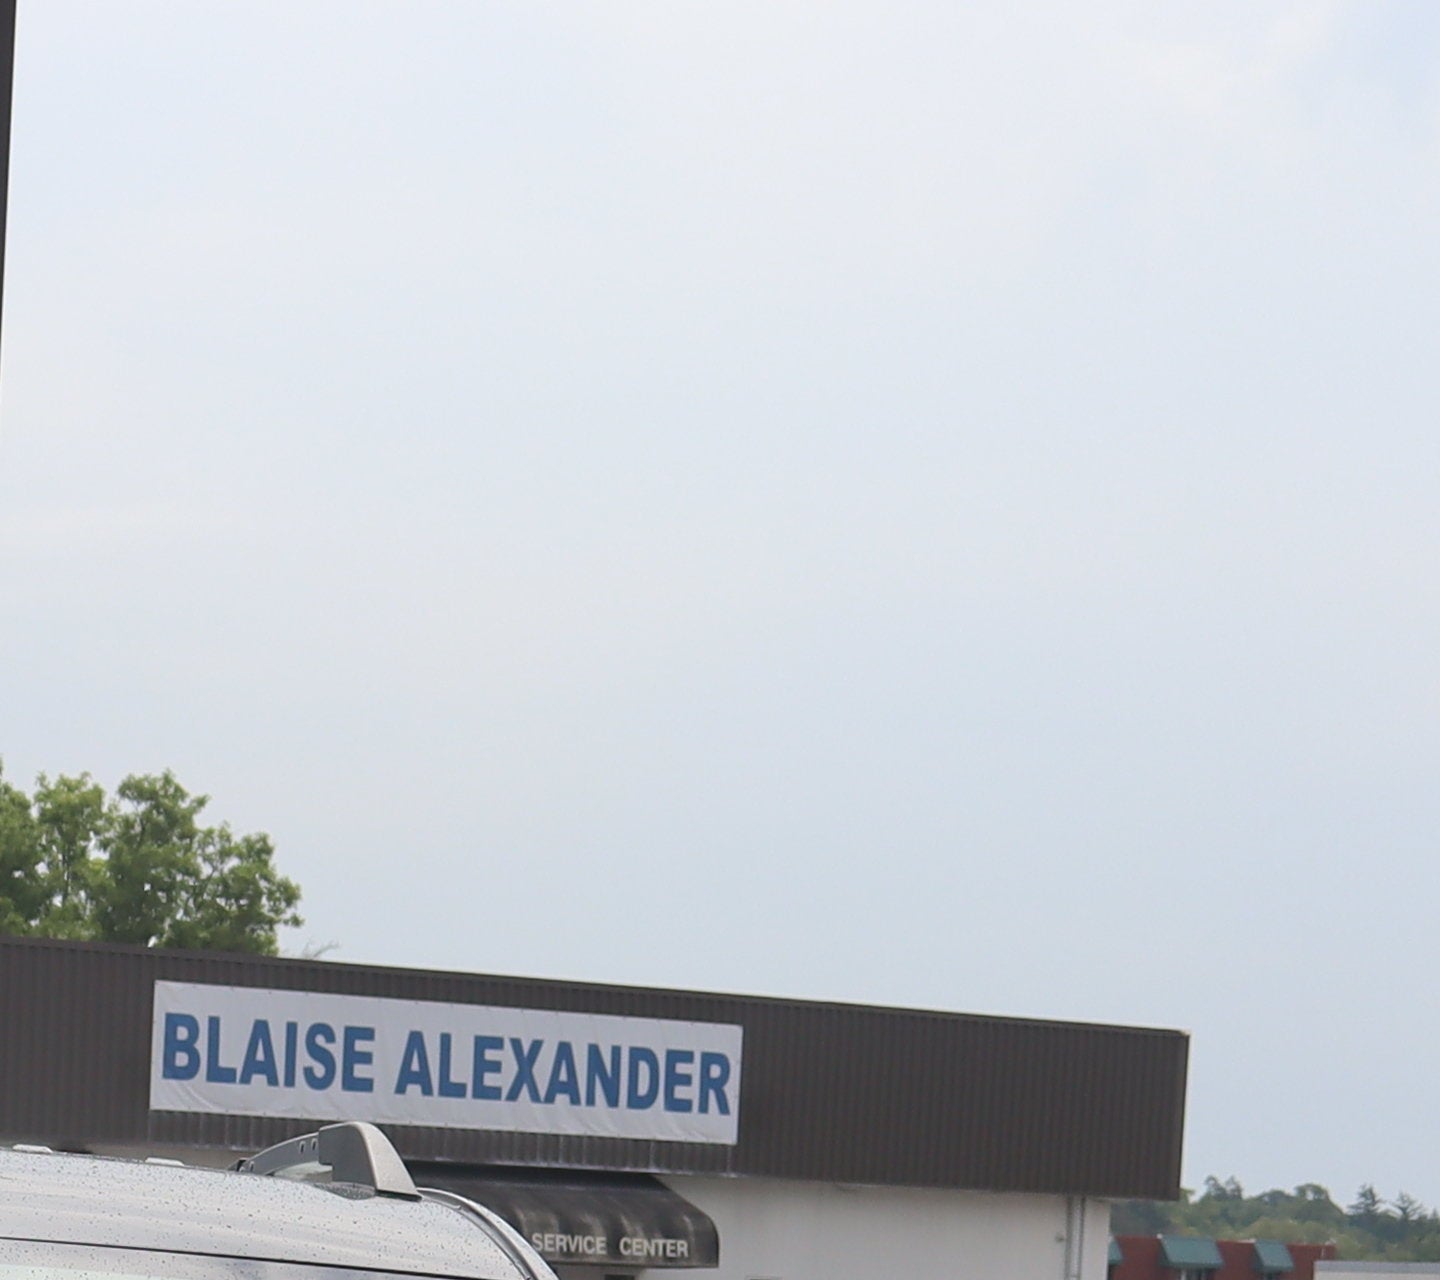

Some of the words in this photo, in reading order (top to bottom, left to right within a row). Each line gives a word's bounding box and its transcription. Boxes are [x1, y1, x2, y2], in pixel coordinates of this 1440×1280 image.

[161, 1012, 376, 1093] BLAISE
[394, 1029, 732, 1117] ALEXANDER
[531, 1232, 607, 1255] SERVICE
[619, 1236, 689, 1258] CENTER
